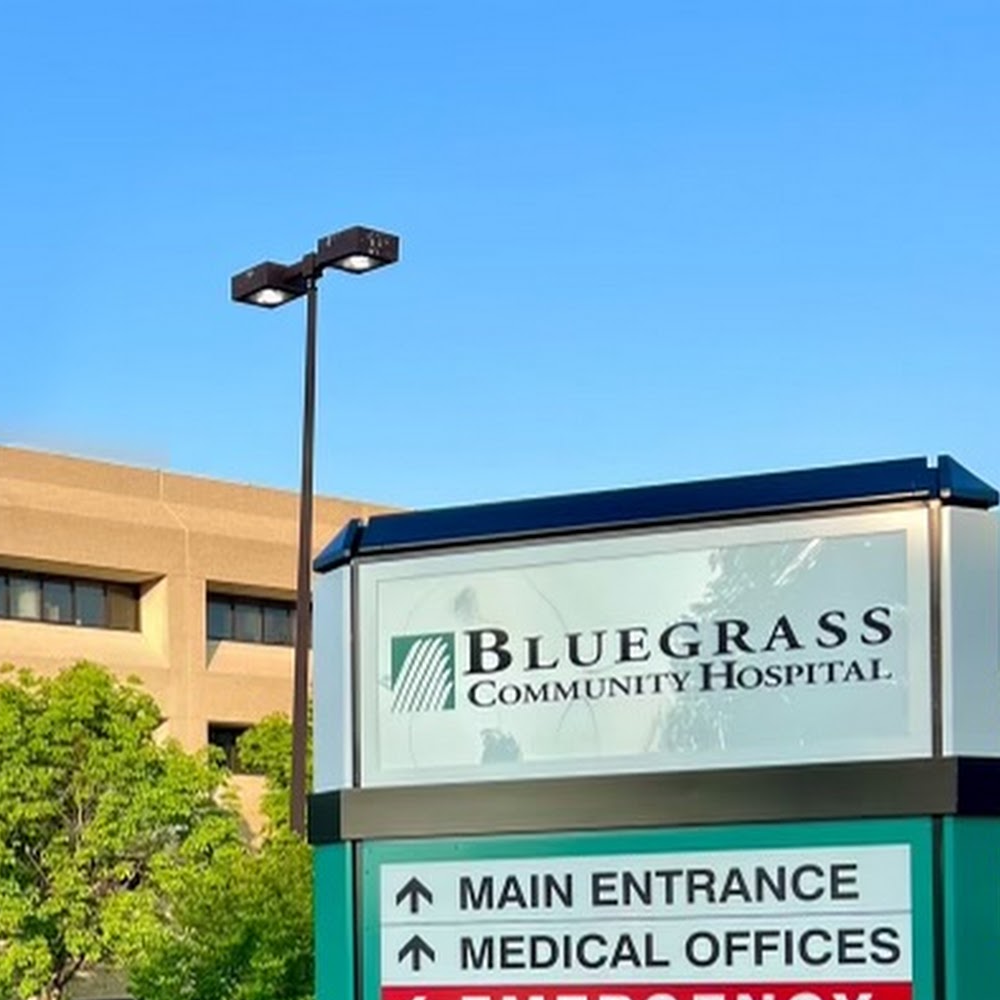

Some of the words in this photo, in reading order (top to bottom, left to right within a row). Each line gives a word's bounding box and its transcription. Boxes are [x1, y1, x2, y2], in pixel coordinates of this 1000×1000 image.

[464, 606, 893, 675] BLUEGRASS
[467, 671, 690, 708] COMMUNITY
[698, 658, 892, 692] HOSPITAL
[459, 873, 573, 911] MAIN
[591, 863, 859, 908] ENTRANCE
[460, 934, 670, 970] MEDICAL
[685, 927, 901, 967] OFFICES
